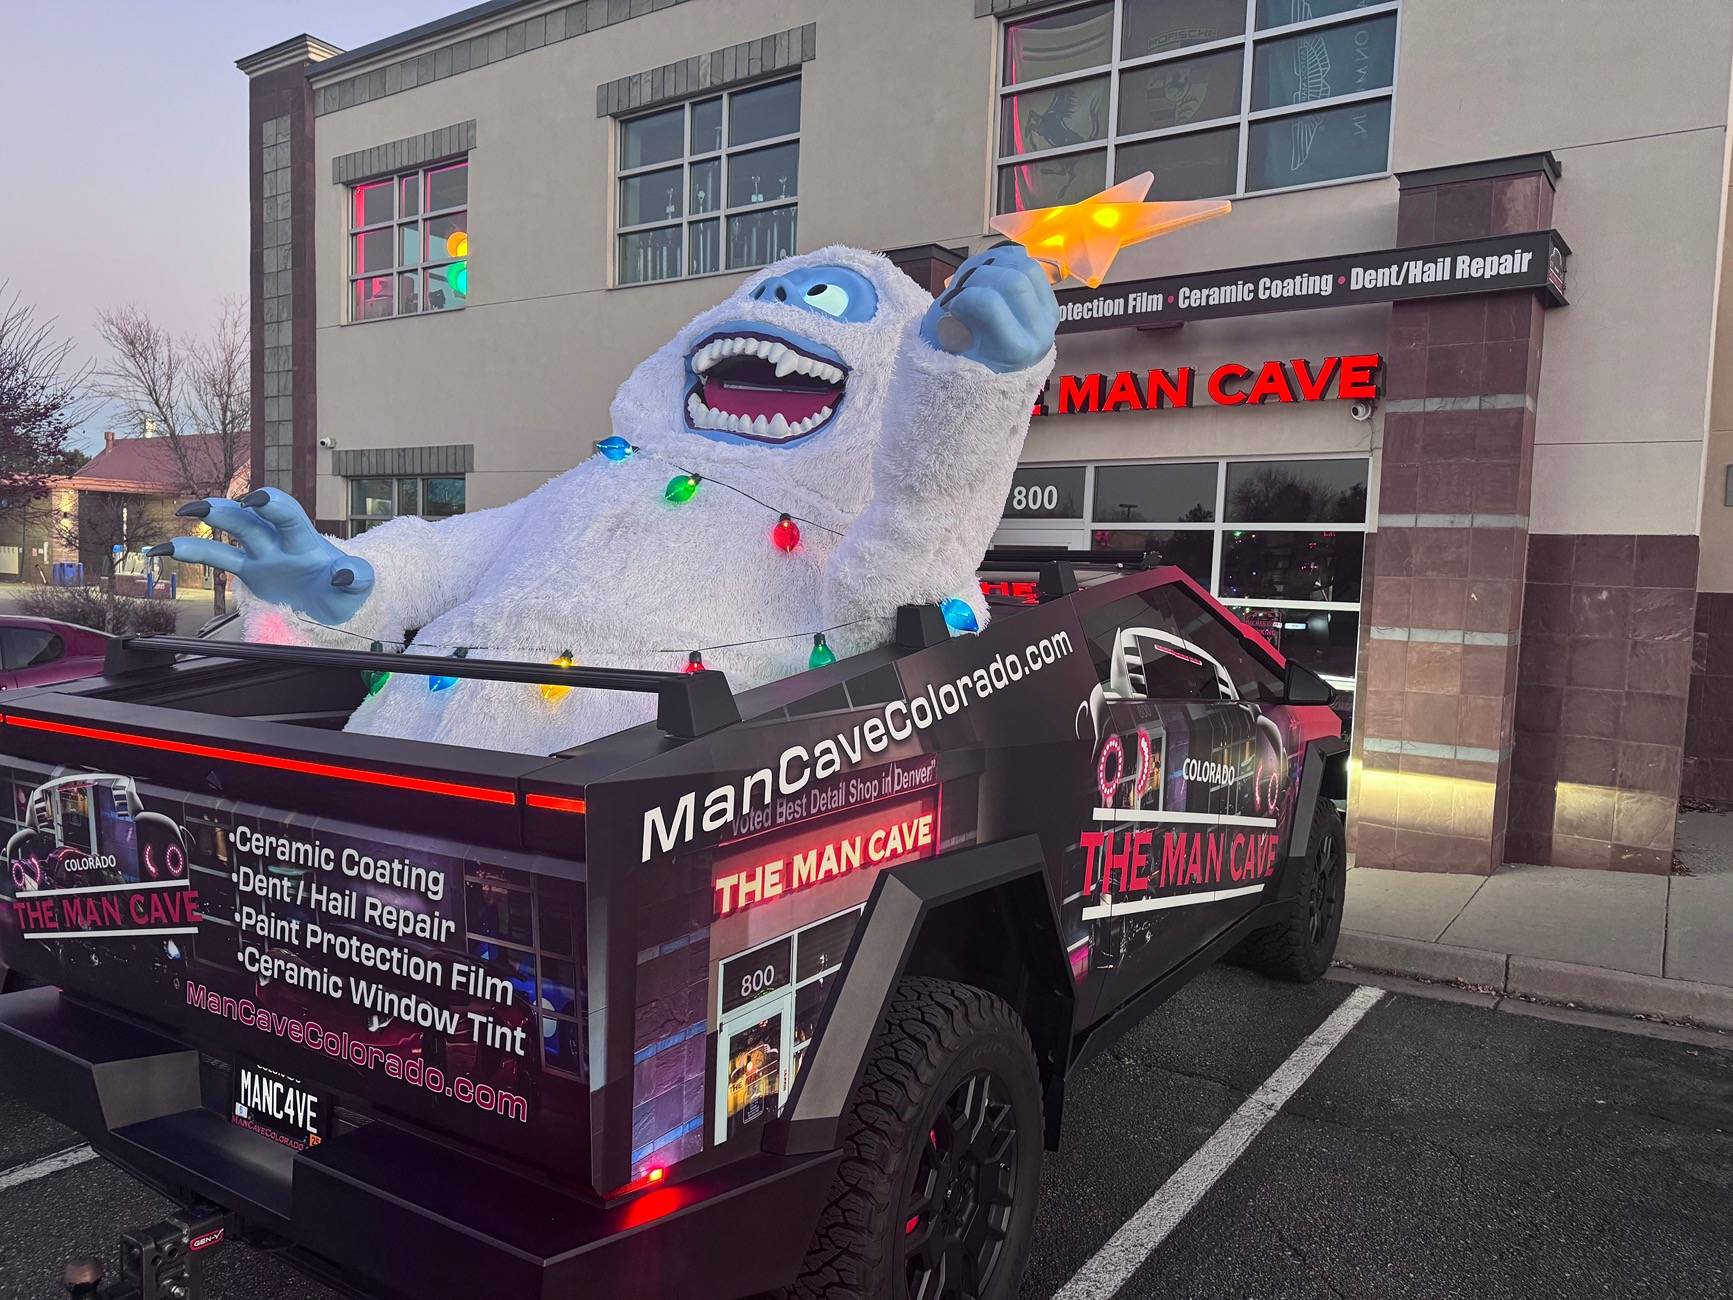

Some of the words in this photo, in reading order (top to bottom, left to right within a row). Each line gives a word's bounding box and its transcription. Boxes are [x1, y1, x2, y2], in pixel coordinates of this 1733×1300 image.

[1059, 296, 1124, 323] otection
[1127, 291, 1163, 314] Film
[1178, 280, 1254, 309] Ceramic
[1258, 273, 1334, 300] Coating
[1350, 256, 1451, 290] Dent/Hail
[1455, 249, 1532, 279] Repair
[1058, 367, 1196, 416] MAN
[1207, 353, 1382, 406] CAVE
[1012, 485, 1058, 511] 800
[641, 628, 1074, 863] ManCaveColorado.com
[1183, 758, 1236, 786] COLORADO
[810, 785, 846, 815] Detail
[849, 775, 879, 805] Shop
[64, 854, 116, 872] COLORADO
[235, 826, 335, 871] Ceramic
[341, 848, 445, 901] Coating
[714, 859, 784, 913] THE
[792, 835, 861, 889] MAN
[868, 814, 933, 862] CAVE
[1080, 832, 1153, 896] THE
[1160, 832, 1225, 888] MAN
[1230, 832, 1279, 881] CAVE
[13, 899, 59, 930] THE
[62, 896, 122, 928] MAN
[128, 890, 203, 926] CAVE
[239, 866, 296, 903] Dent
[310, 883, 356, 919] Hail
[364, 896, 456, 943] Repair
[242, 906, 299, 945] Paint
[306, 922, 442, 987] Protection
[451, 962, 514, 1006] Film
[740, 964, 775, 997] 800
[244, 946, 343, 999] Ceramic
[350, 977, 459, 1035] Window
[467, 1012, 526, 1056] Tint
[186, 980, 528, 1122] ManCaveColorado.com
[241, 1068, 318, 1134] MANC4VE
